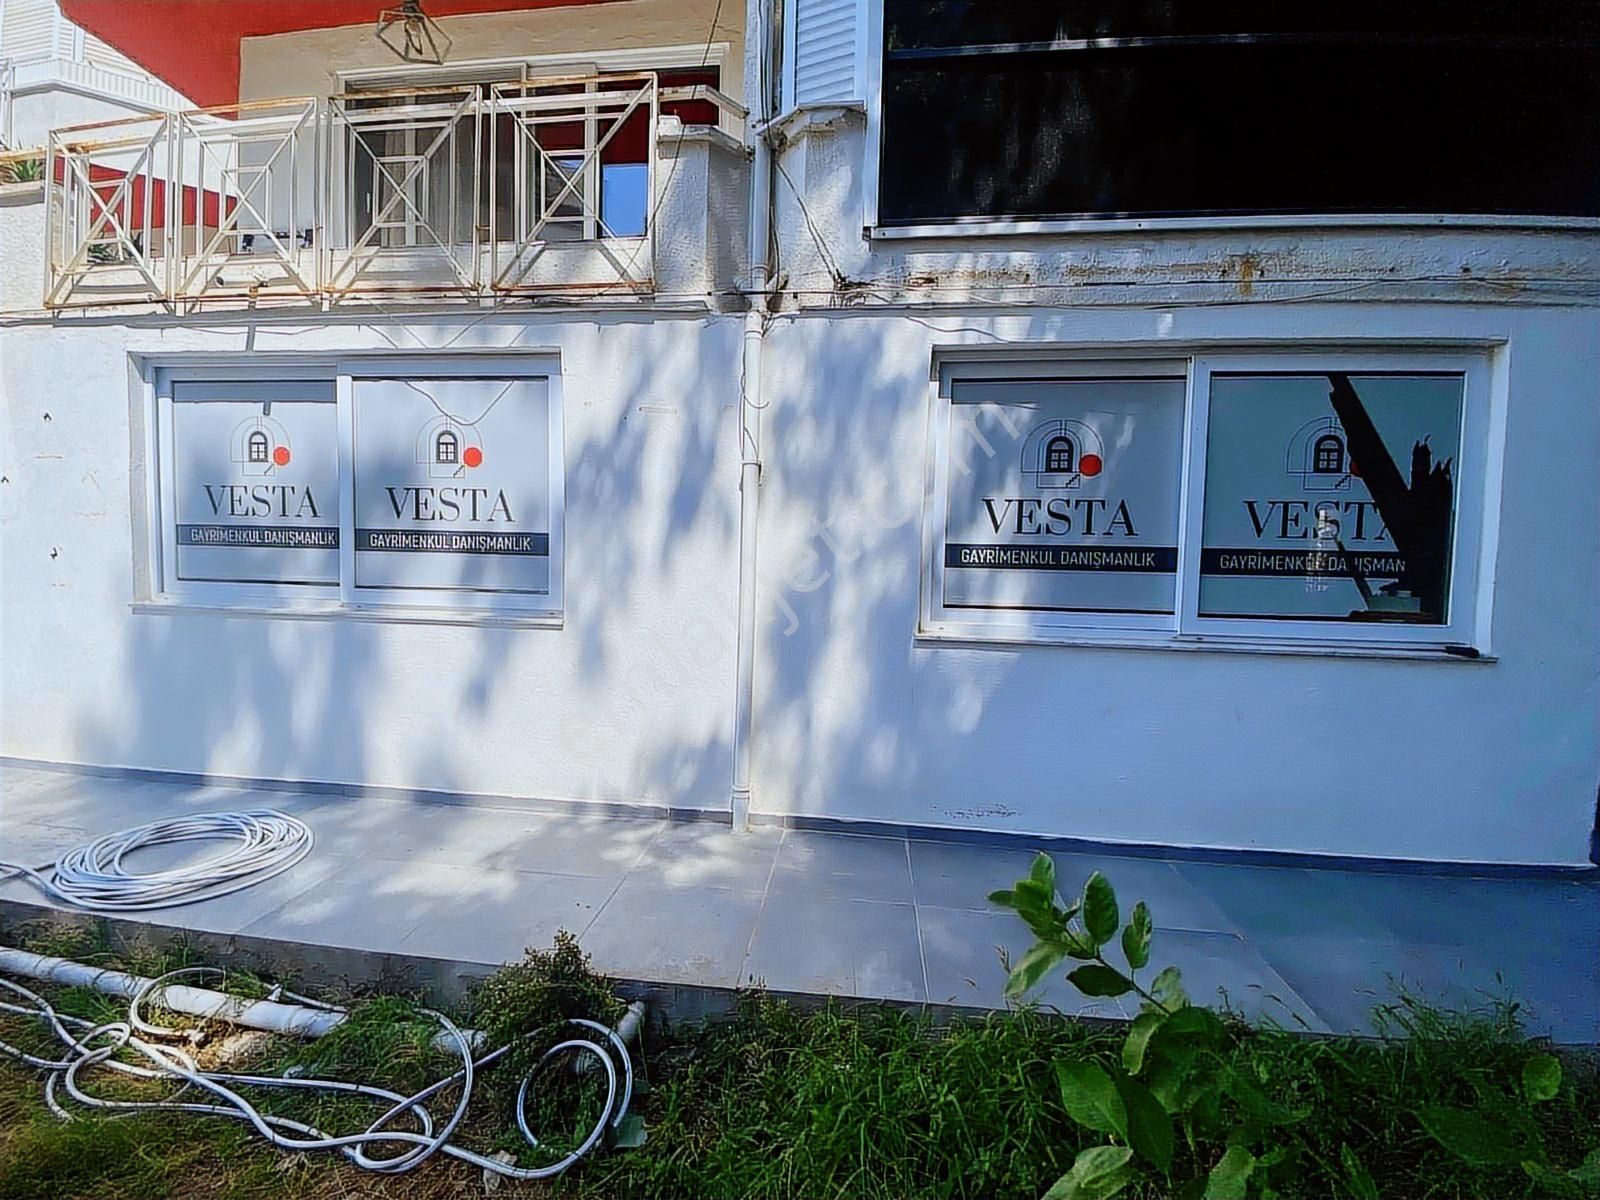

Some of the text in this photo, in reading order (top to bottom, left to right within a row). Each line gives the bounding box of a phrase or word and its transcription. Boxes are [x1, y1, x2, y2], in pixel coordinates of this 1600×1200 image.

[203, 484, 321, 518] VESTA
[385, 486, 516, 522] VESTA
[982, 498, 1139, 537] VESTA
[191, 526, 336, 547] GAYRİMENKUL DANIŞMANLIK
[369, 531, 531, 552] GAYRİMENKUL DANIŞMANLIK
[961, 546, 1155, 568] GAYRİMENKUL DANIŞMANLIK
